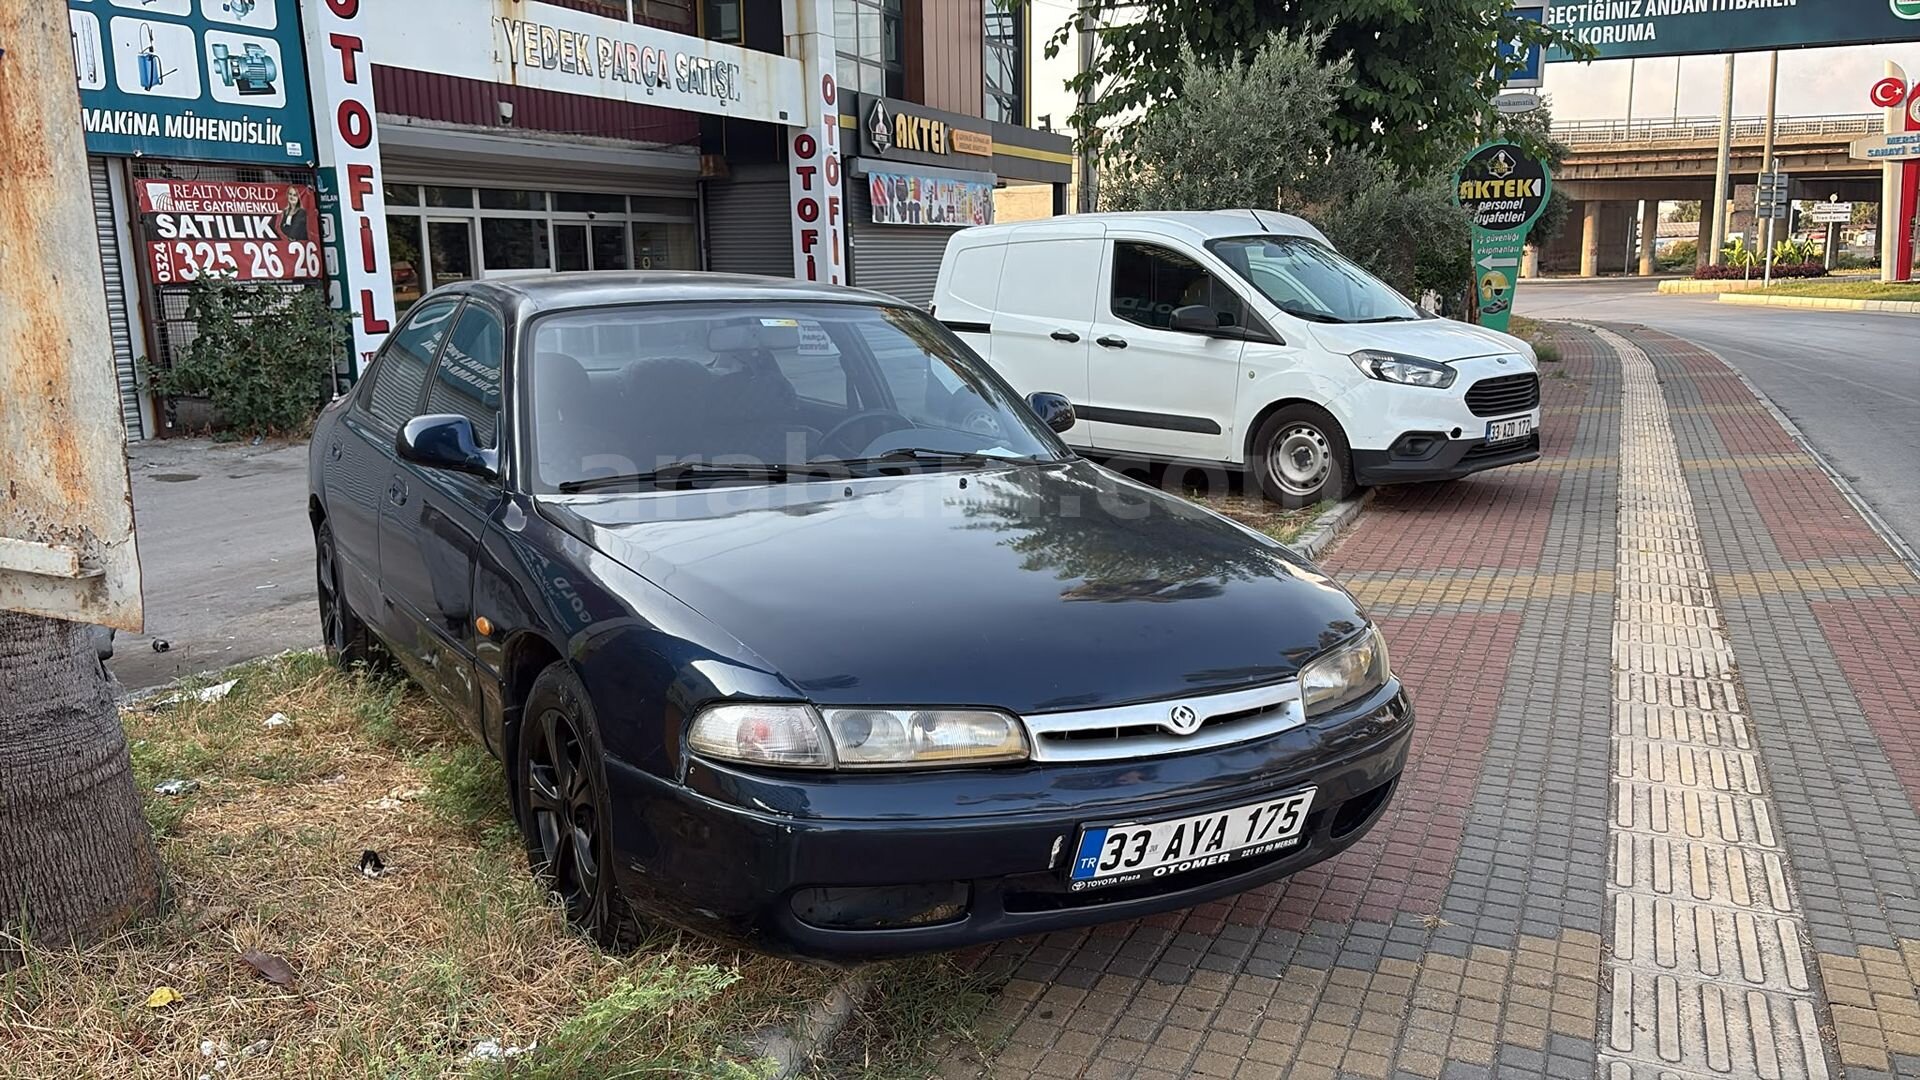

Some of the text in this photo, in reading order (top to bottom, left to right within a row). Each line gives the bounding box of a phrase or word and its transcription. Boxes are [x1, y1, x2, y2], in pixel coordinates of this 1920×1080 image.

[1645, 0, 1708, 17] ANDAN
[1579, 22, 1656, 45] KORUMA
[503, 18, 593, 77] YEDEK
[597, 37, 671, 95] PARÇA
[165, 111, 283, 146] MÜHENDİSLİK
[821, 73, 840, 285] OTOFİ
[1460, 179, 1533, 199] AKTEK
[173, 184, 222, 199] REALTY
[175, 199, 283, 213] MEF GAYRİMENKUL
[1479, 198, 1524, 211] personel
[156, 213, 278, 239] SATILIK
[154, 241, 320, 282] 0324 325 26 26
[1491, 424, 1500, 440] 33
[1519, 419, 1531, 435] 172
[1100, 798, 1305, 871] 33 AYA 175
[1080, 857, 1097, 869] TR
[1087, 877, 1118, 888] TOYOTA
[1119, 873, 1141, 883] Plaza
[1153, 853, 1231, 877] OTOMER
